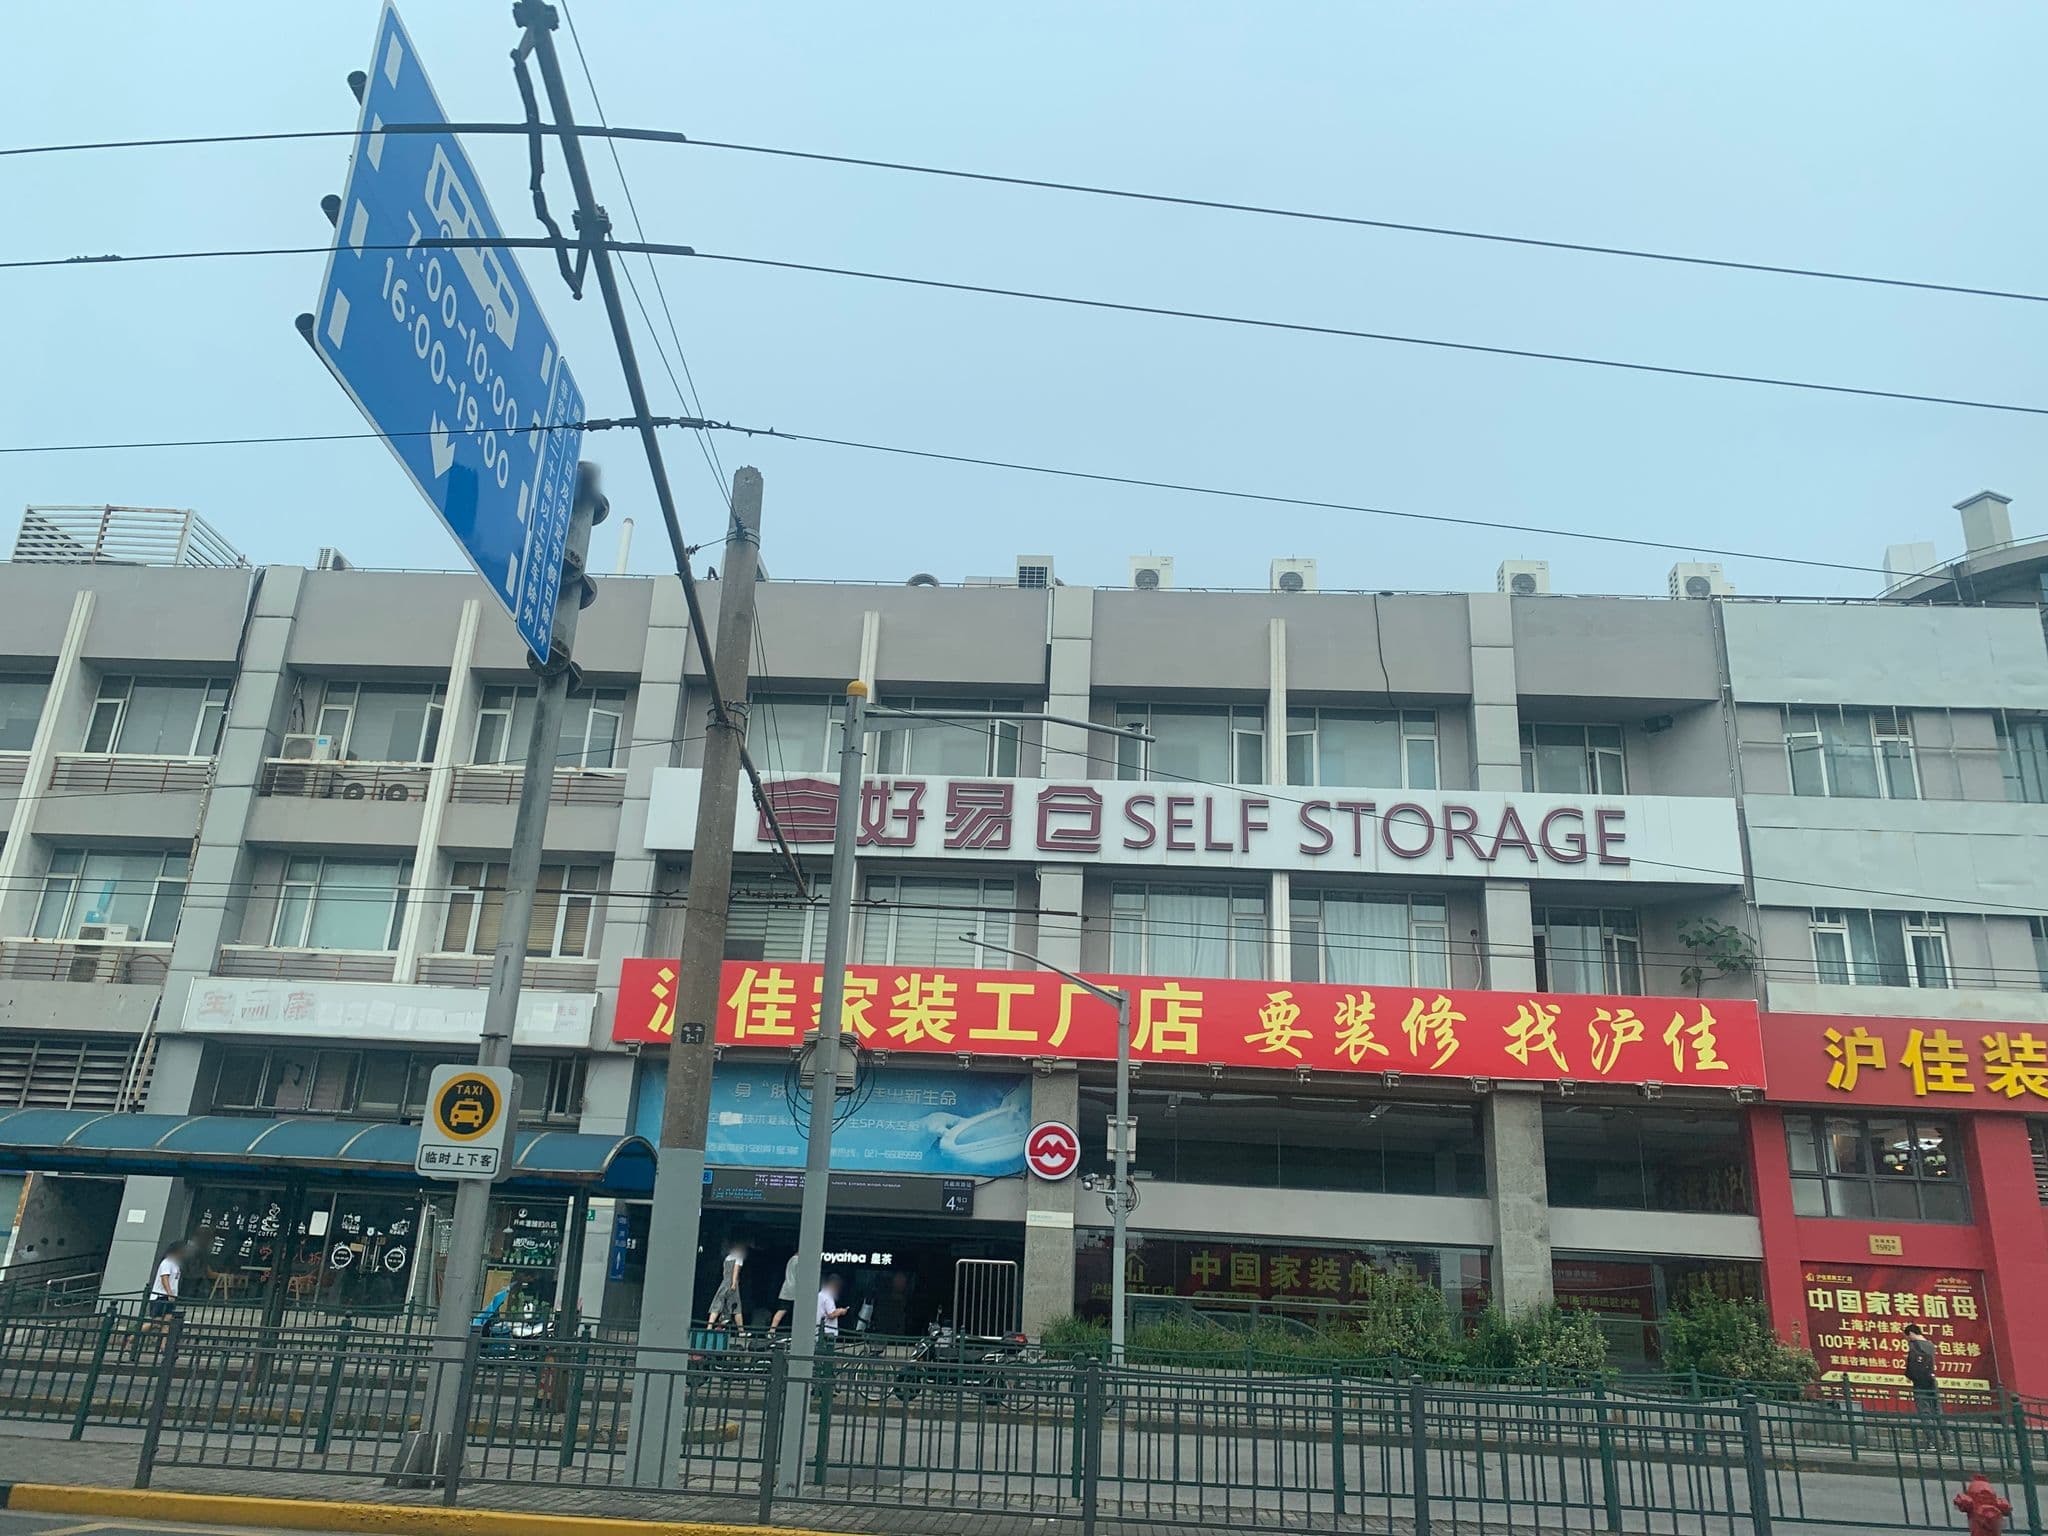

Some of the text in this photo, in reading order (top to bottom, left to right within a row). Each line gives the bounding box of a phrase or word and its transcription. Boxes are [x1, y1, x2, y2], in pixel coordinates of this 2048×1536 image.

[406, 210, 518, 438] 7:00-10:00
[382, 256, 510, 490] 16:00-19:00
[1122, 793, 1272, 854] SELF
[1298, 799, 1632, 866] STORAGE
[1823, 1026, 2048, 1099] 沪佳装
[456, 1084, 484, 1096] TAXI
[424, 1150, 493, 1168] 临时上下客
[945, 1195, 957, 1211] 4
[820, 1251, 893, 1266] royaltea 皇茶
[1807, 1287, 1979, 1321] 中国家装航母
